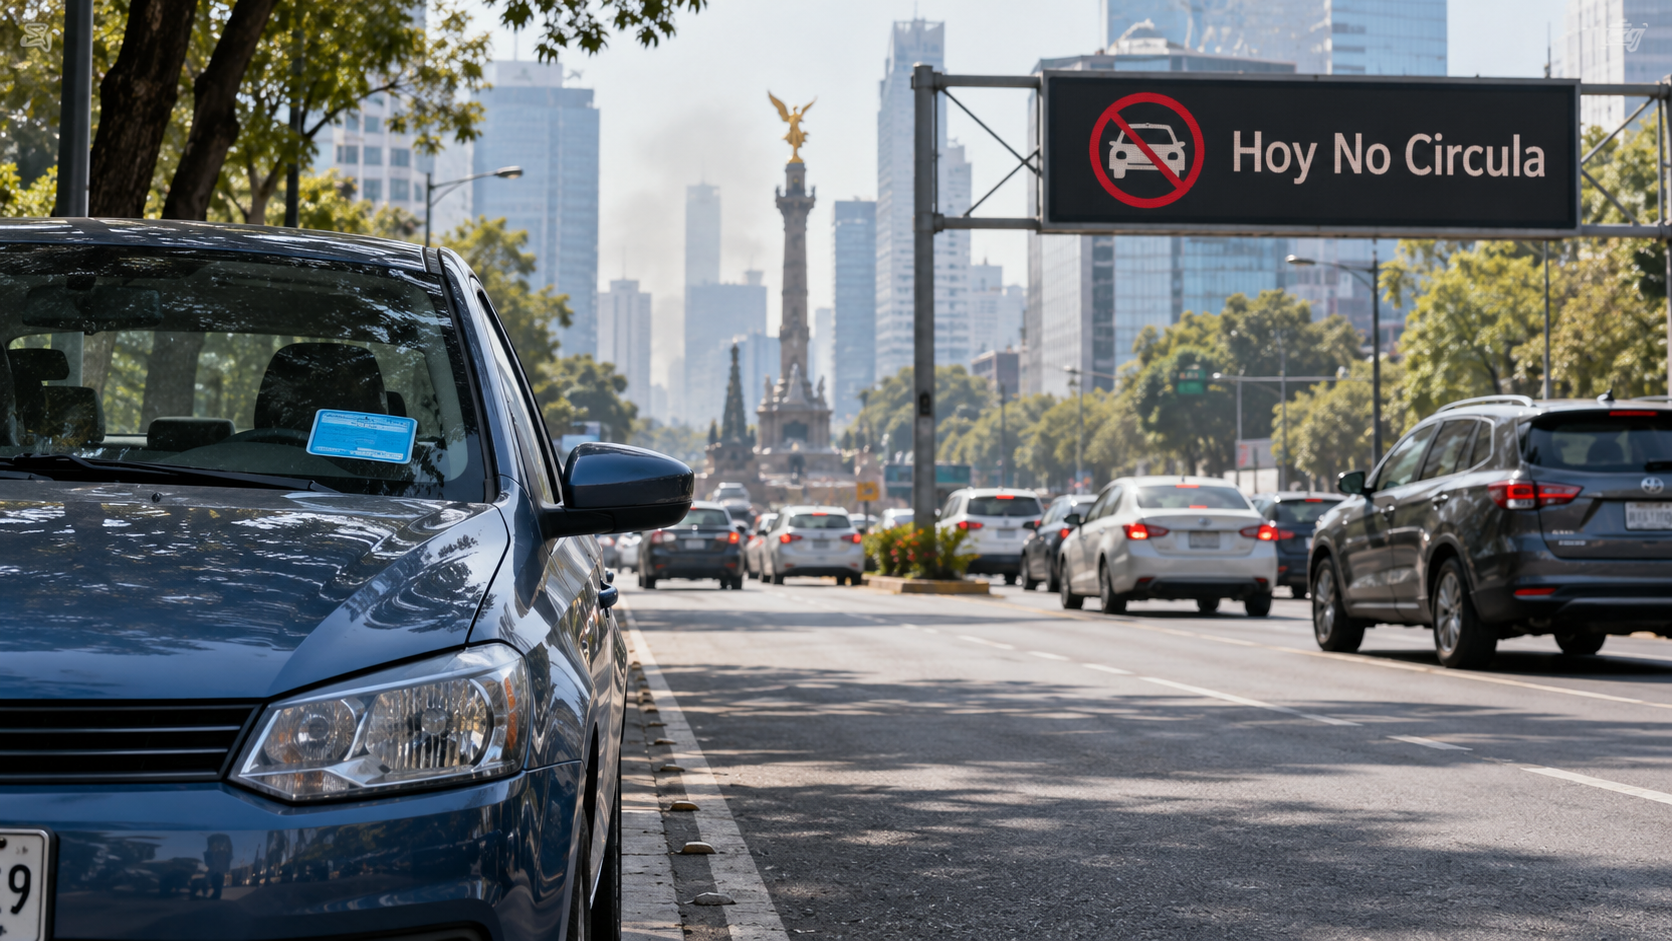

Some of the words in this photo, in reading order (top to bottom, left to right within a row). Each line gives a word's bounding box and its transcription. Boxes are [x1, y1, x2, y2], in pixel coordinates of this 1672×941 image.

[1233, 130, 1318, 185] Hoy
[1334, 132, 1392, 175] No
[1405, 132, 1546, 178] Circula
[0, 863, 32, 916] 9
